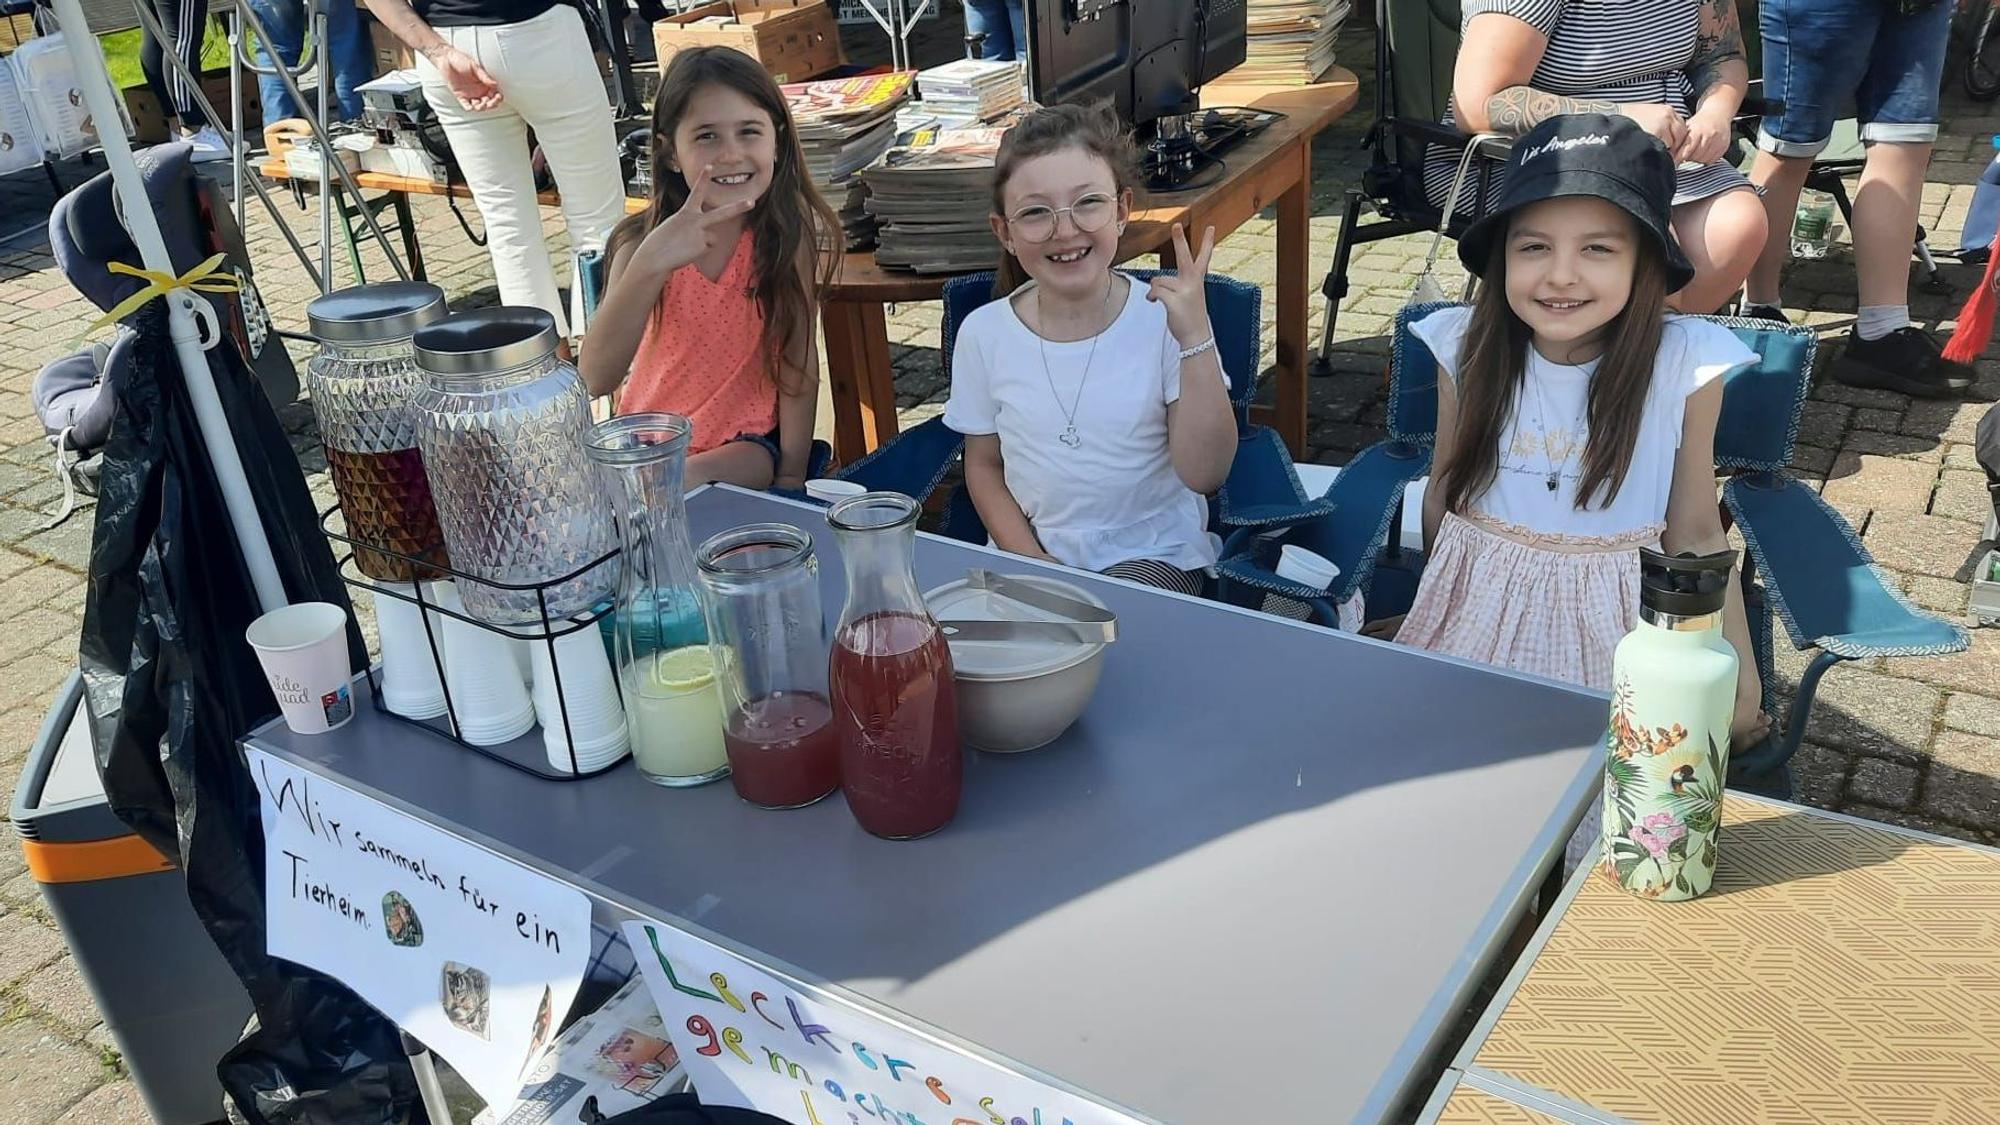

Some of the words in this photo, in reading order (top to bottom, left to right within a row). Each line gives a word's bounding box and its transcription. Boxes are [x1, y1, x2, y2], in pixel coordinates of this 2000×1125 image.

[1540, 132, 1610, 152] Angeles
[260, 758, 343, 848] Wir
[458, 875, 499, 918] für
[515, 911, 561, 954] ein
[643, 925, 952, 1106] Leckere
